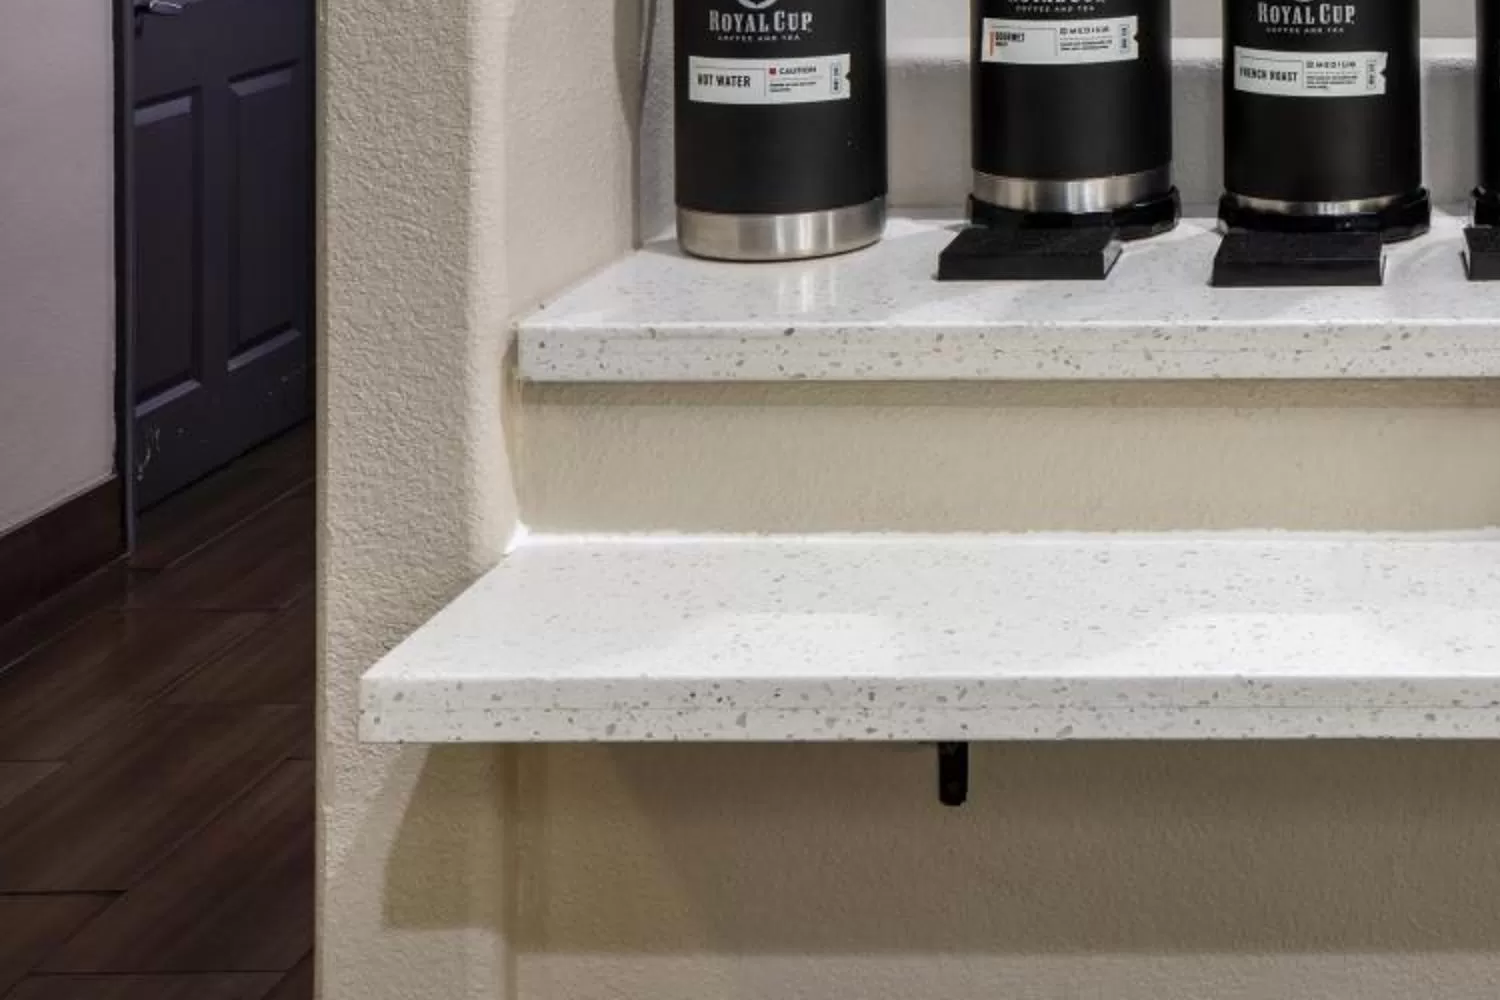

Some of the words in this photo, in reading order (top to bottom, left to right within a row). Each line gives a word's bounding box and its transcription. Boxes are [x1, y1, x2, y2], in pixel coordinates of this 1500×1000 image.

[709, 10, 769, 33] ROYAL
[773, 10, 812, 32] CUP
[1257, 2, 1315, 25] ROYAL
[1319, 3, 1355, 24] CUP
[697, 73, 713, 86] HOT
[716, 75, 751, 88] WATER
[1239, 66, 1267, 80] FRENCH
[1269, 70, 1298, 82] ROAST
